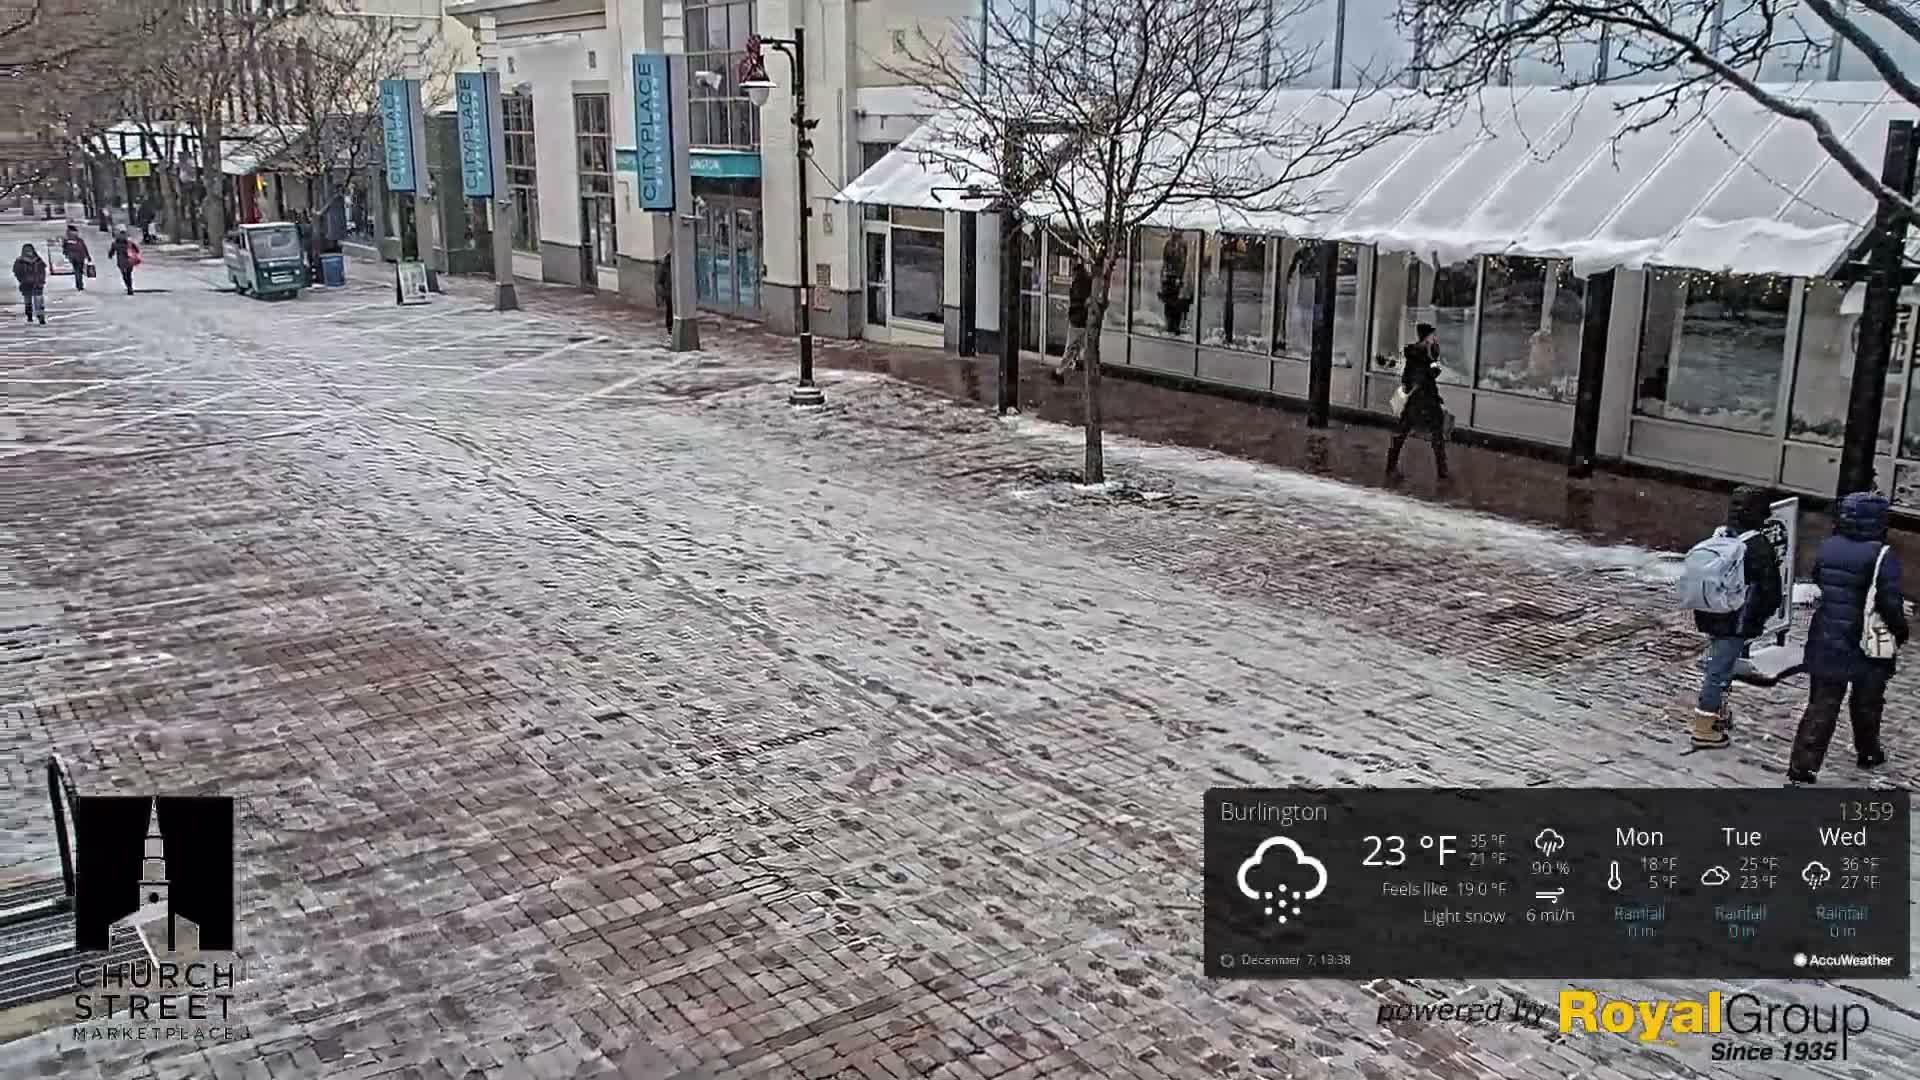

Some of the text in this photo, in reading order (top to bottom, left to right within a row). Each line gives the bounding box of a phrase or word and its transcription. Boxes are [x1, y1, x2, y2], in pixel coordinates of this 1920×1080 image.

[383, 86, 401, 185] CITYPLACE
[460, 79, 478, 190] CITYPLACE
[639, 63, 657, 201] CITYPLACE
